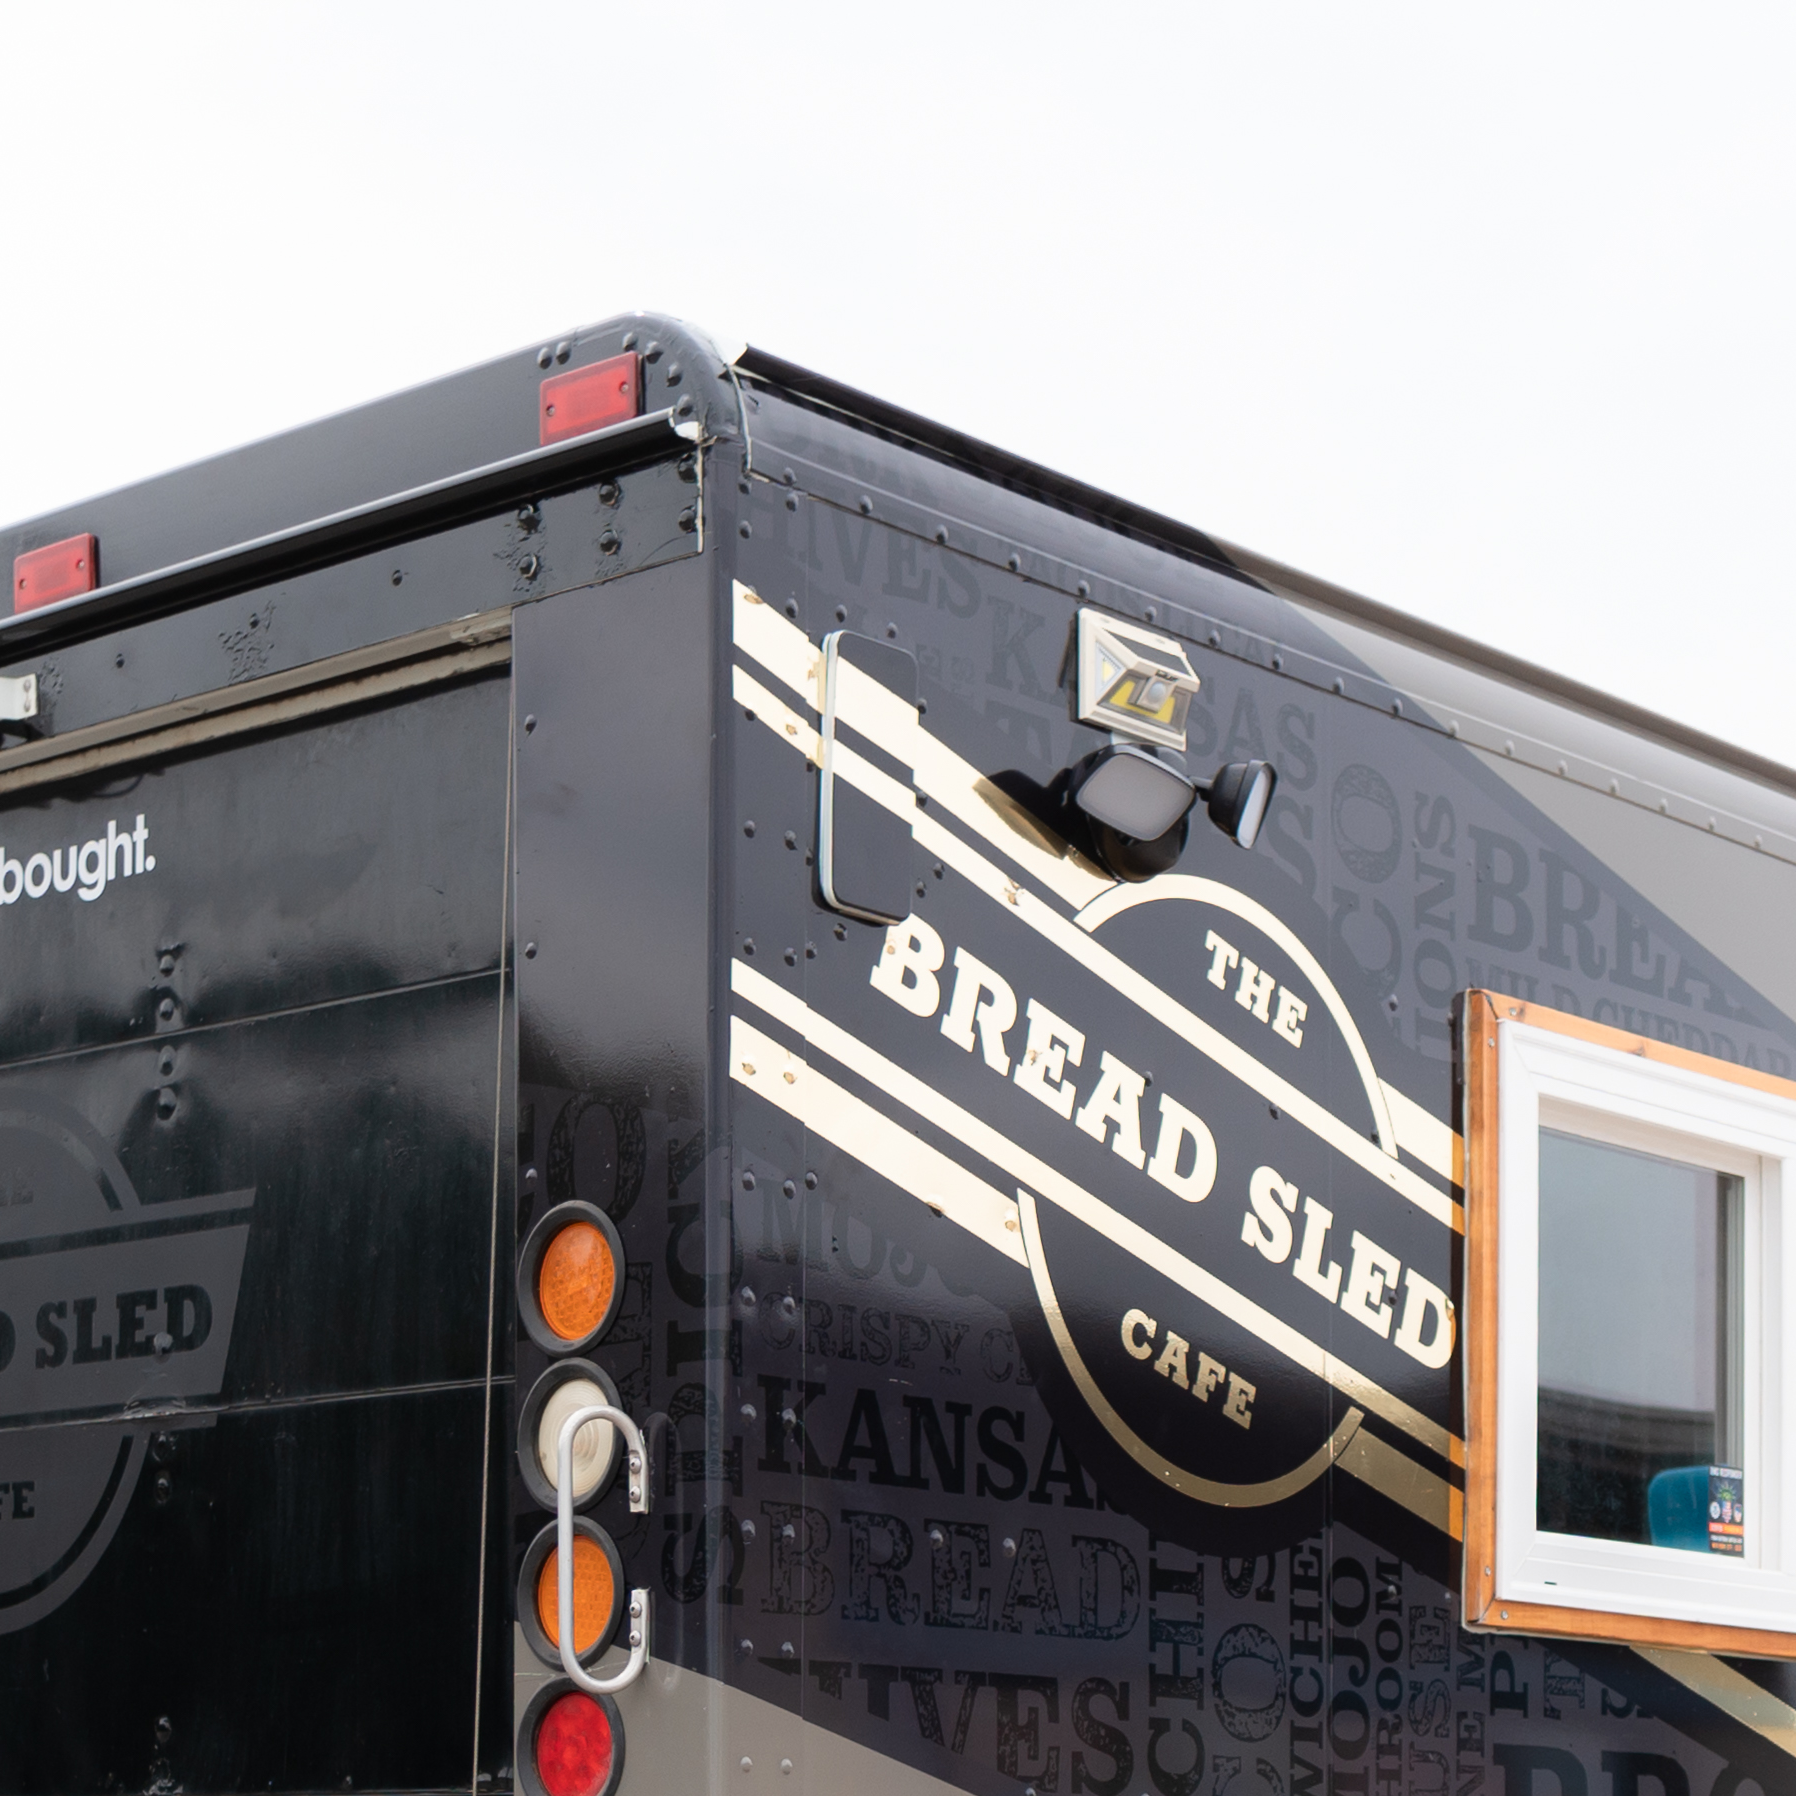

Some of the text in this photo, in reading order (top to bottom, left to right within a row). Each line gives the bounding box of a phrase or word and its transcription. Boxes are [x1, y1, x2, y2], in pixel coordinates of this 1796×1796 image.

[1205, 929, 1308, 1050] THE
[869, 912, 1219, 1204] BREAD
[1241, 1165, 1457, 1370] SLED
[34, 1283, 214, 1370] SLED
[1121, 1308, 1258, 1430] CAFE
[760, 1500, 1141, 1642] BREAD
